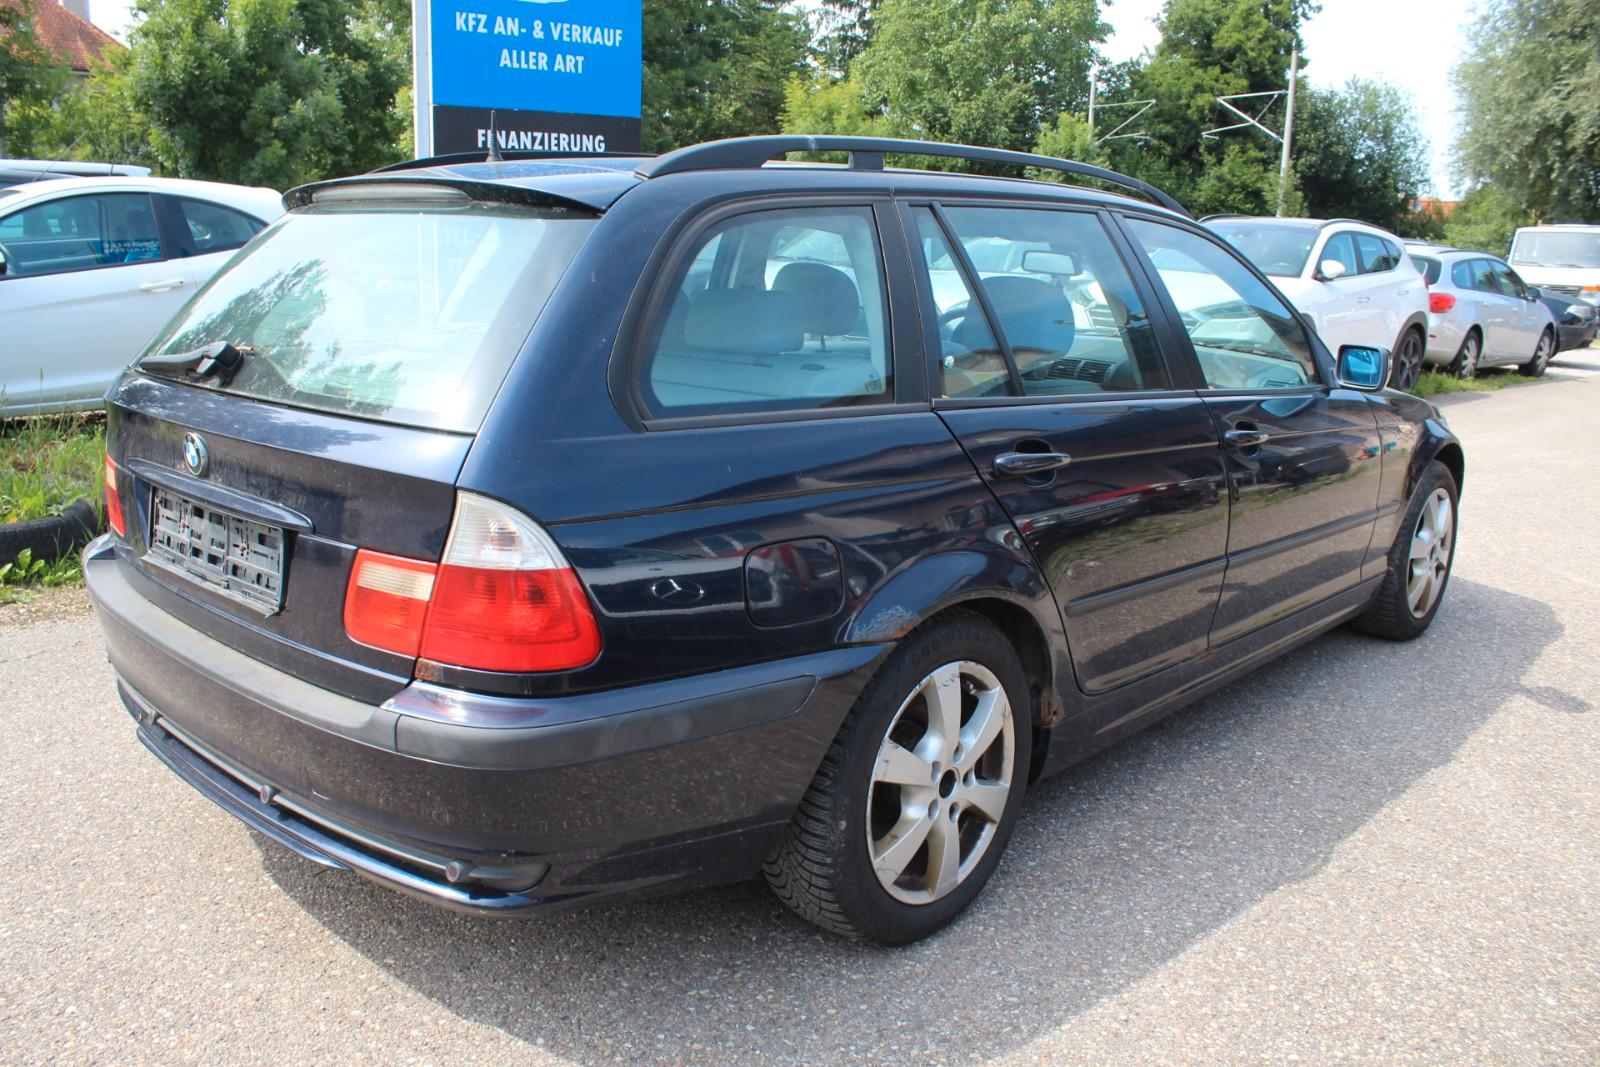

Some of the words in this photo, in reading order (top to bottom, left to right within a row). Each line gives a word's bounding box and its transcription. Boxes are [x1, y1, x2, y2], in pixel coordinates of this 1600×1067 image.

[455, 11, 488, 34] KFZ
[493, 16, 527, 37] AN-
[532, 19, 545, 40] &
[550, 21, 623, 47] VERKAUF
[500, 48, 548, 71] ALLER
[553, 54, 584, 74] ART
[477, 128, 606, 152] FINANZIERUNG
